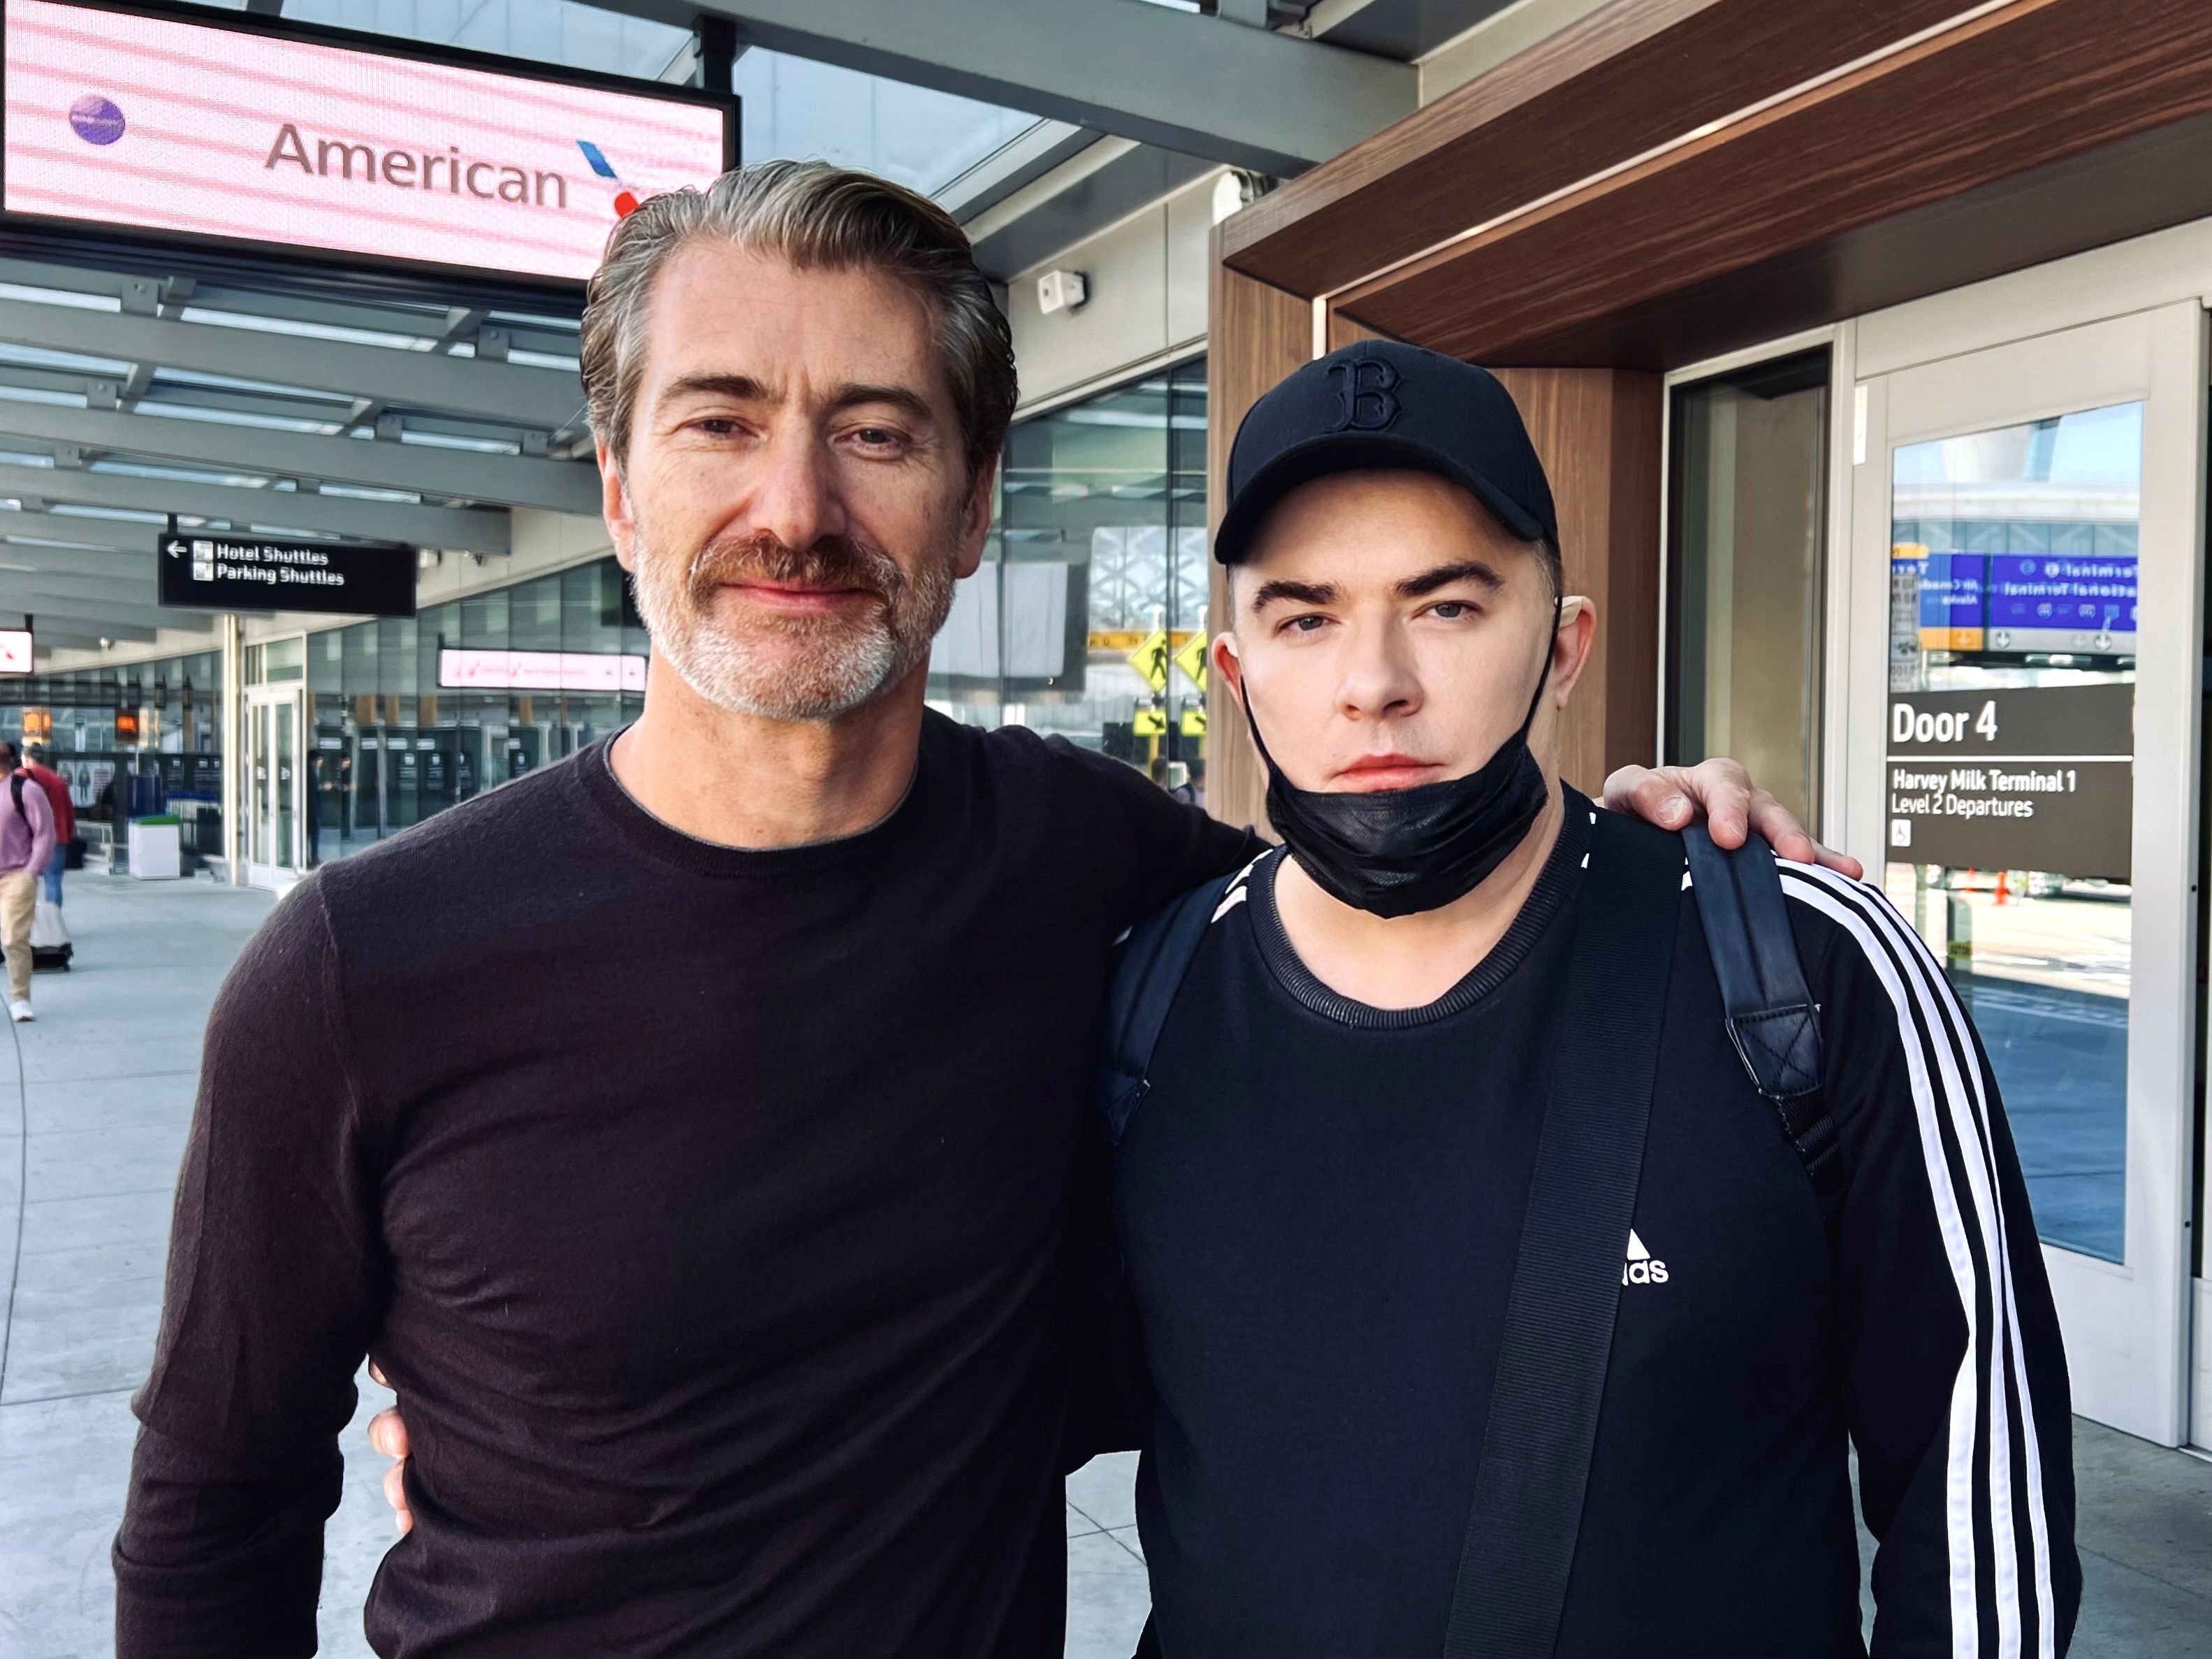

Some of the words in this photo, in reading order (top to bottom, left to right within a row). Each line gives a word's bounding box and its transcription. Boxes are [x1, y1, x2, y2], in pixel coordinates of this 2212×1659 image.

[265, 124, 567, 209] American
[1322, 357, 1402, 432] B
[217, 543, 261, 561] Hotel
[263, 546, 329, 565] Shuttles
[217, 563, 277, 584] Parking
[279, 566, 345, 586] Shuttles
[1892, 703, 1970, 743] Door
[1975, 700, 1998, 741] 4
[1892, 768, 1948, 794] Harvey
[1950, 769, 1987, 791] Milk
[1988, 769, 2064, 792] Terminal
[2066, 769, 2076, 792] 1
[1891, 792, 1931, 813] Level
[1932, 793, 1942, 815] 2
[1946, 793, 2035, 819] Departures
